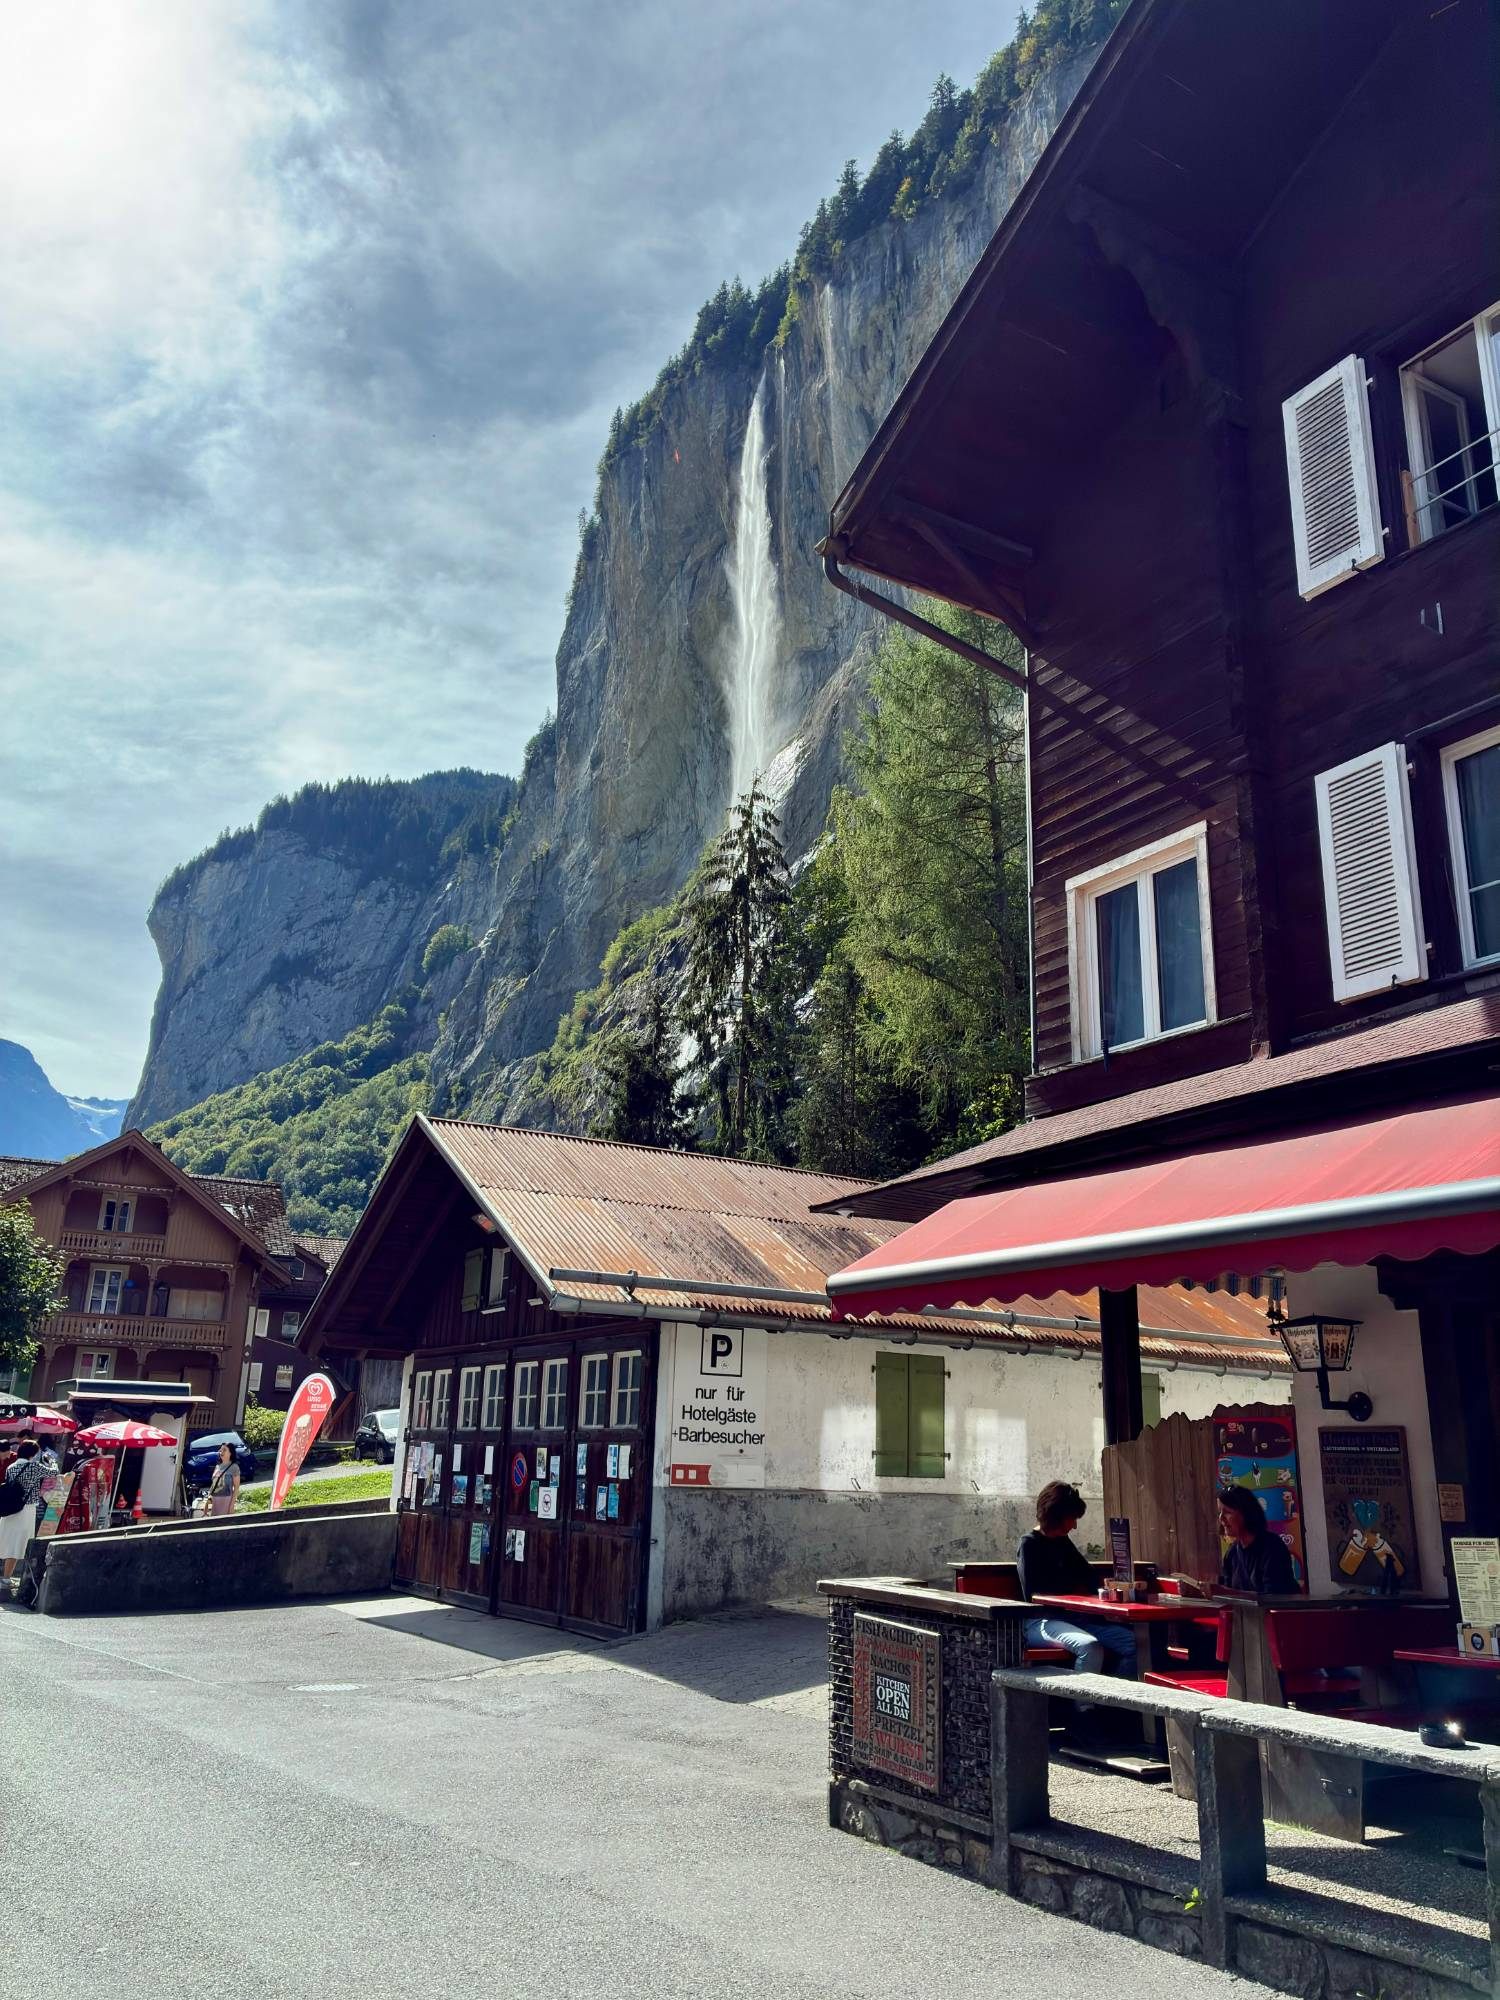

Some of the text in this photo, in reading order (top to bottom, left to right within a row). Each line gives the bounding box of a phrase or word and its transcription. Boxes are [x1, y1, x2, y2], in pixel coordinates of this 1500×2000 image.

[711, 1333, 732, 1368] P
[695, 1386, 745, 1401] nur für
[681, 1405, 757, 1425] Hotelgäste
[870, 1654, 912, 1676] NACHOS
[876, 1675, 911, 1694] KITCHEN
[876, 1686, 911, 1709] OPEN
[876, 1700, 911, 1720] ALL DAY
[926, 1652, 936, 1773] RACLETTE
[874, 1714, 924, 1743] PRETZEL
[874, 1731, 924, 1761] WURST
[899, 1757, 925, 1771] SALAD
